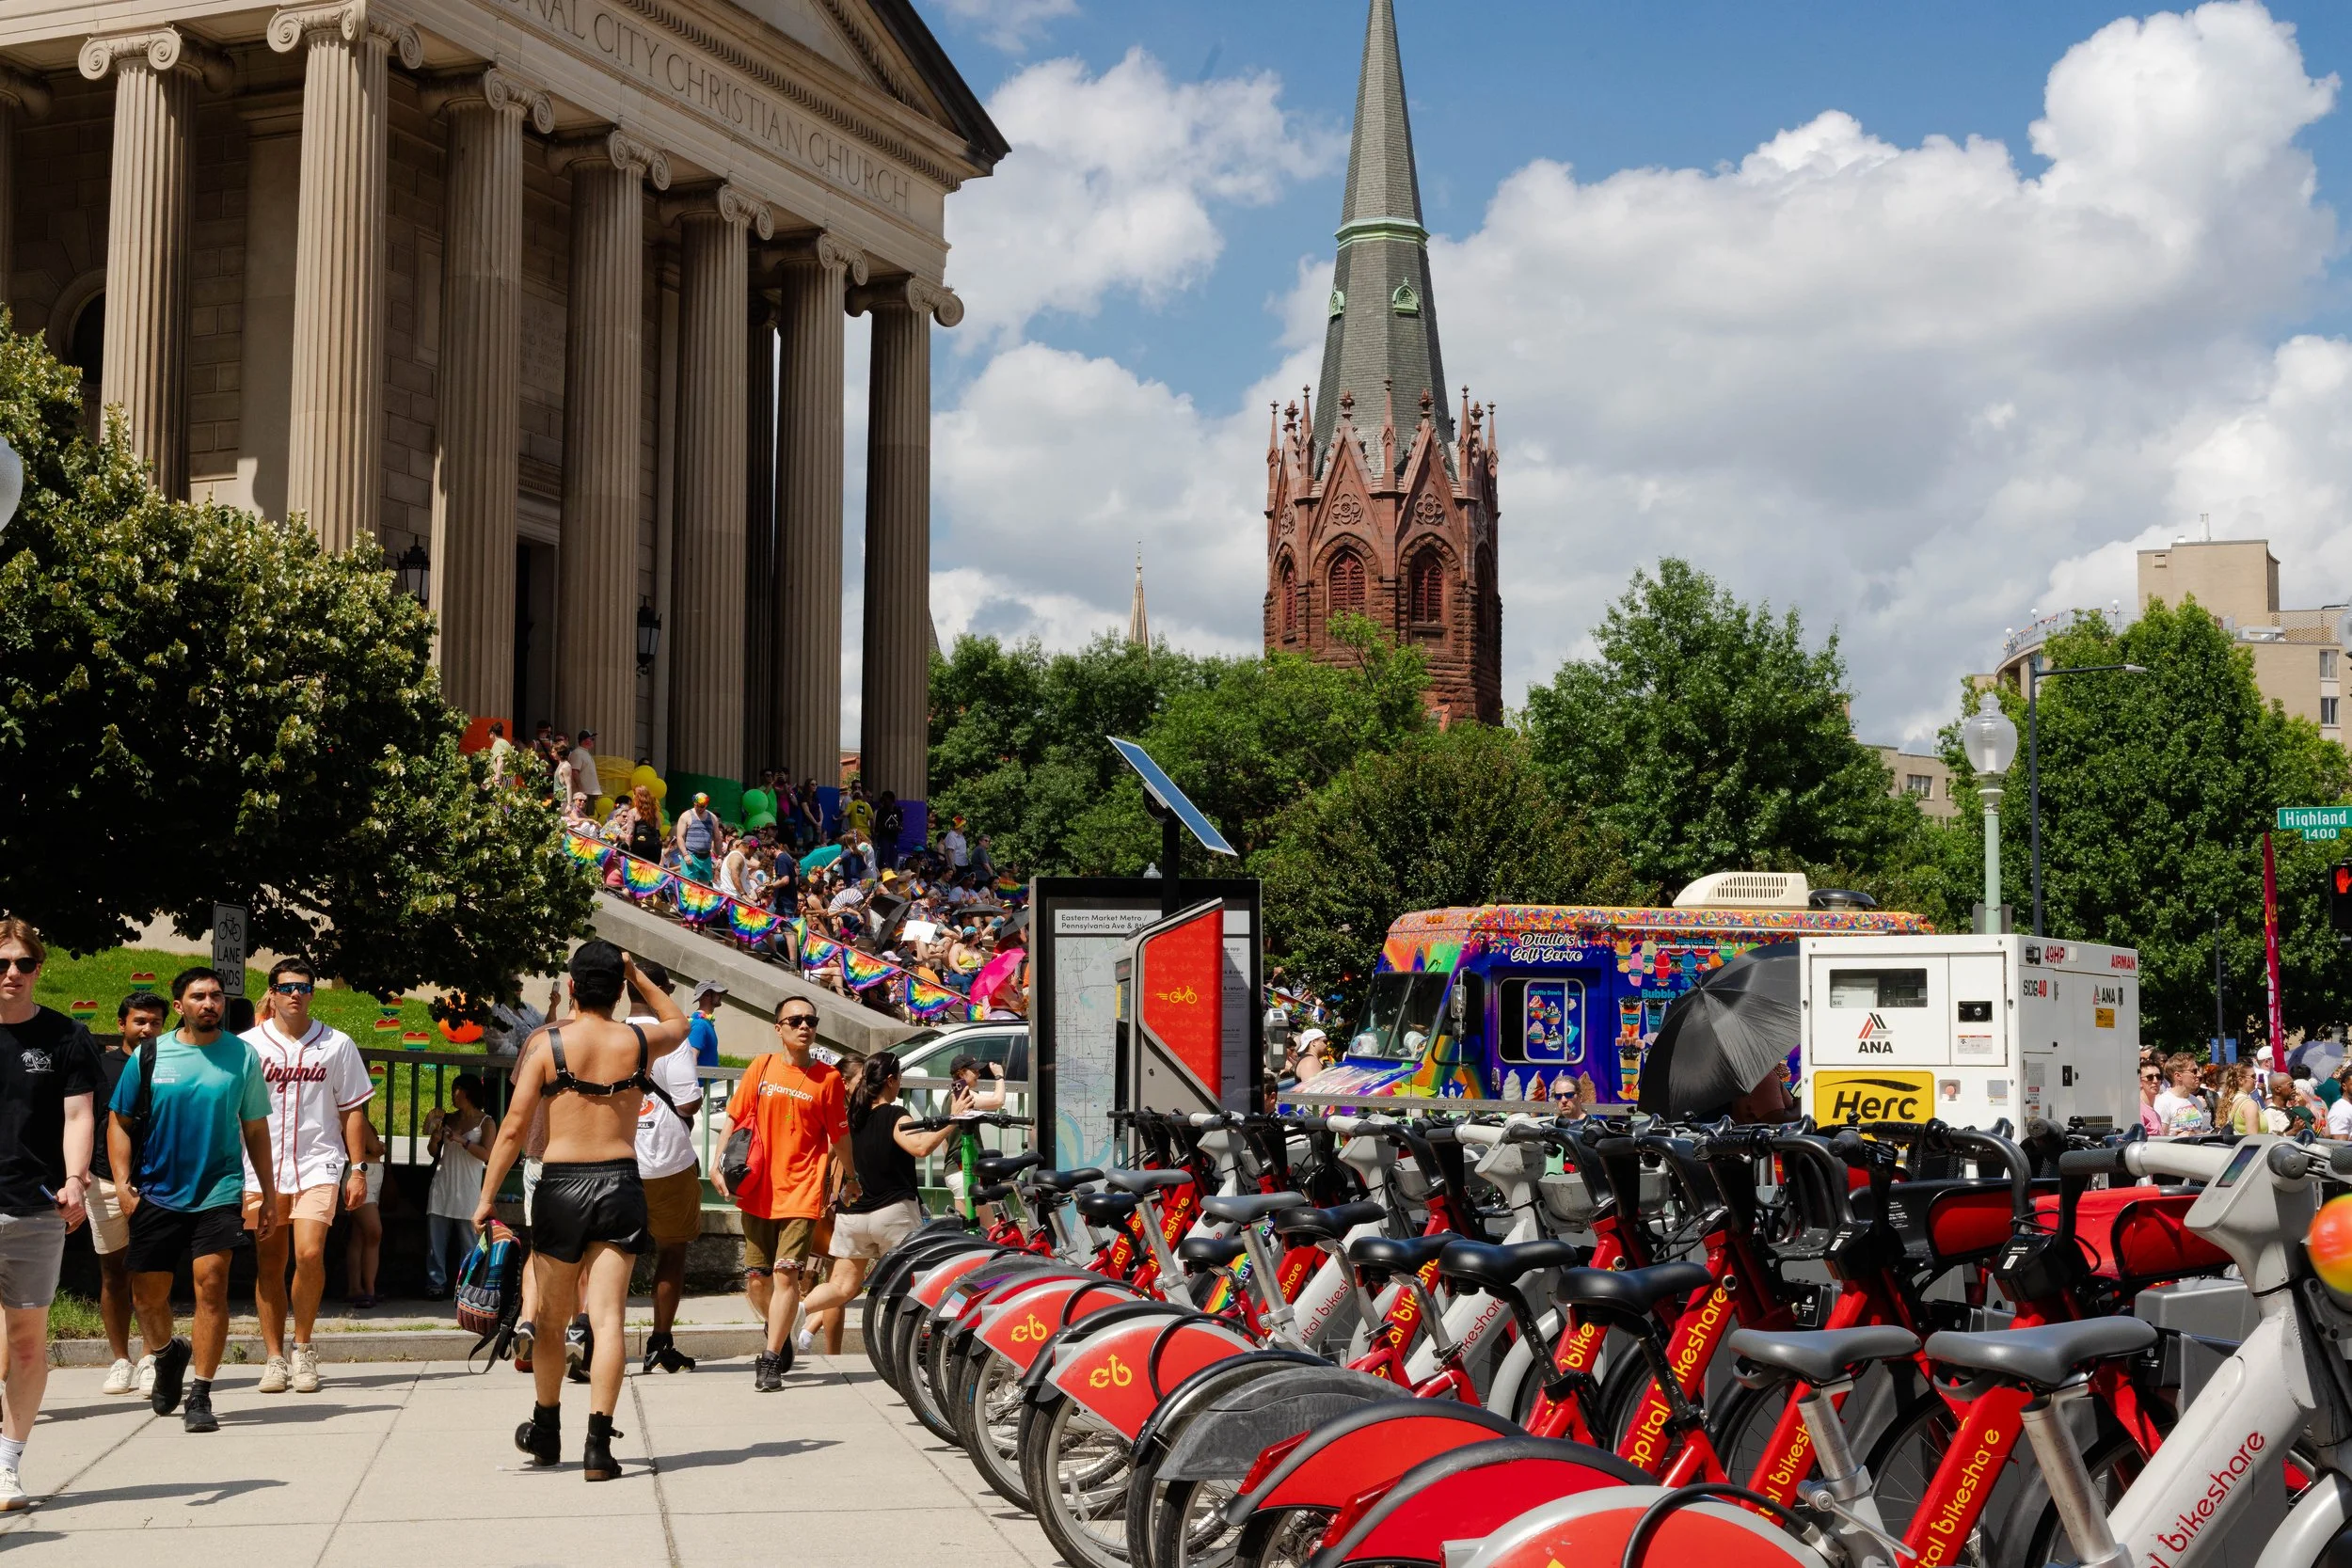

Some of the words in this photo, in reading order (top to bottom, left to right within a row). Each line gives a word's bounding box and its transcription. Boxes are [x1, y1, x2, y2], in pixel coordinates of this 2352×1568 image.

[595, 13, 660, 77] CITY
[667, 54, 803, 158] CHRISTIAN
[809, 132, 910, 214] CHURCH
[2285, 810, 2347, 827] Highland
[2304, 829, 2336, 839] 1400
[1519, 933, 1575, 946] Diallo's
[217, 945, 241, 964] LANE
[1511, 947, 1539, 963] Soft
[1542, 947, 1582, 962] Serve
[2045, 945, 2065, 964] 49HP
[2111, 954, 2136, 971] AIRMAN
[1641, 989, 1677, 998] Bubble
[2024, 979, 2047, 997] SDG40
[2102, 988, 2116, 1004] ANA
[1858, 1041, 1894, 1053] ANA
[768, 1083, 813, 1102] glamazon
[1832, 1091, 1919, 1120] Herc
[2156, 1430, 2266, 1555] bikeshare
